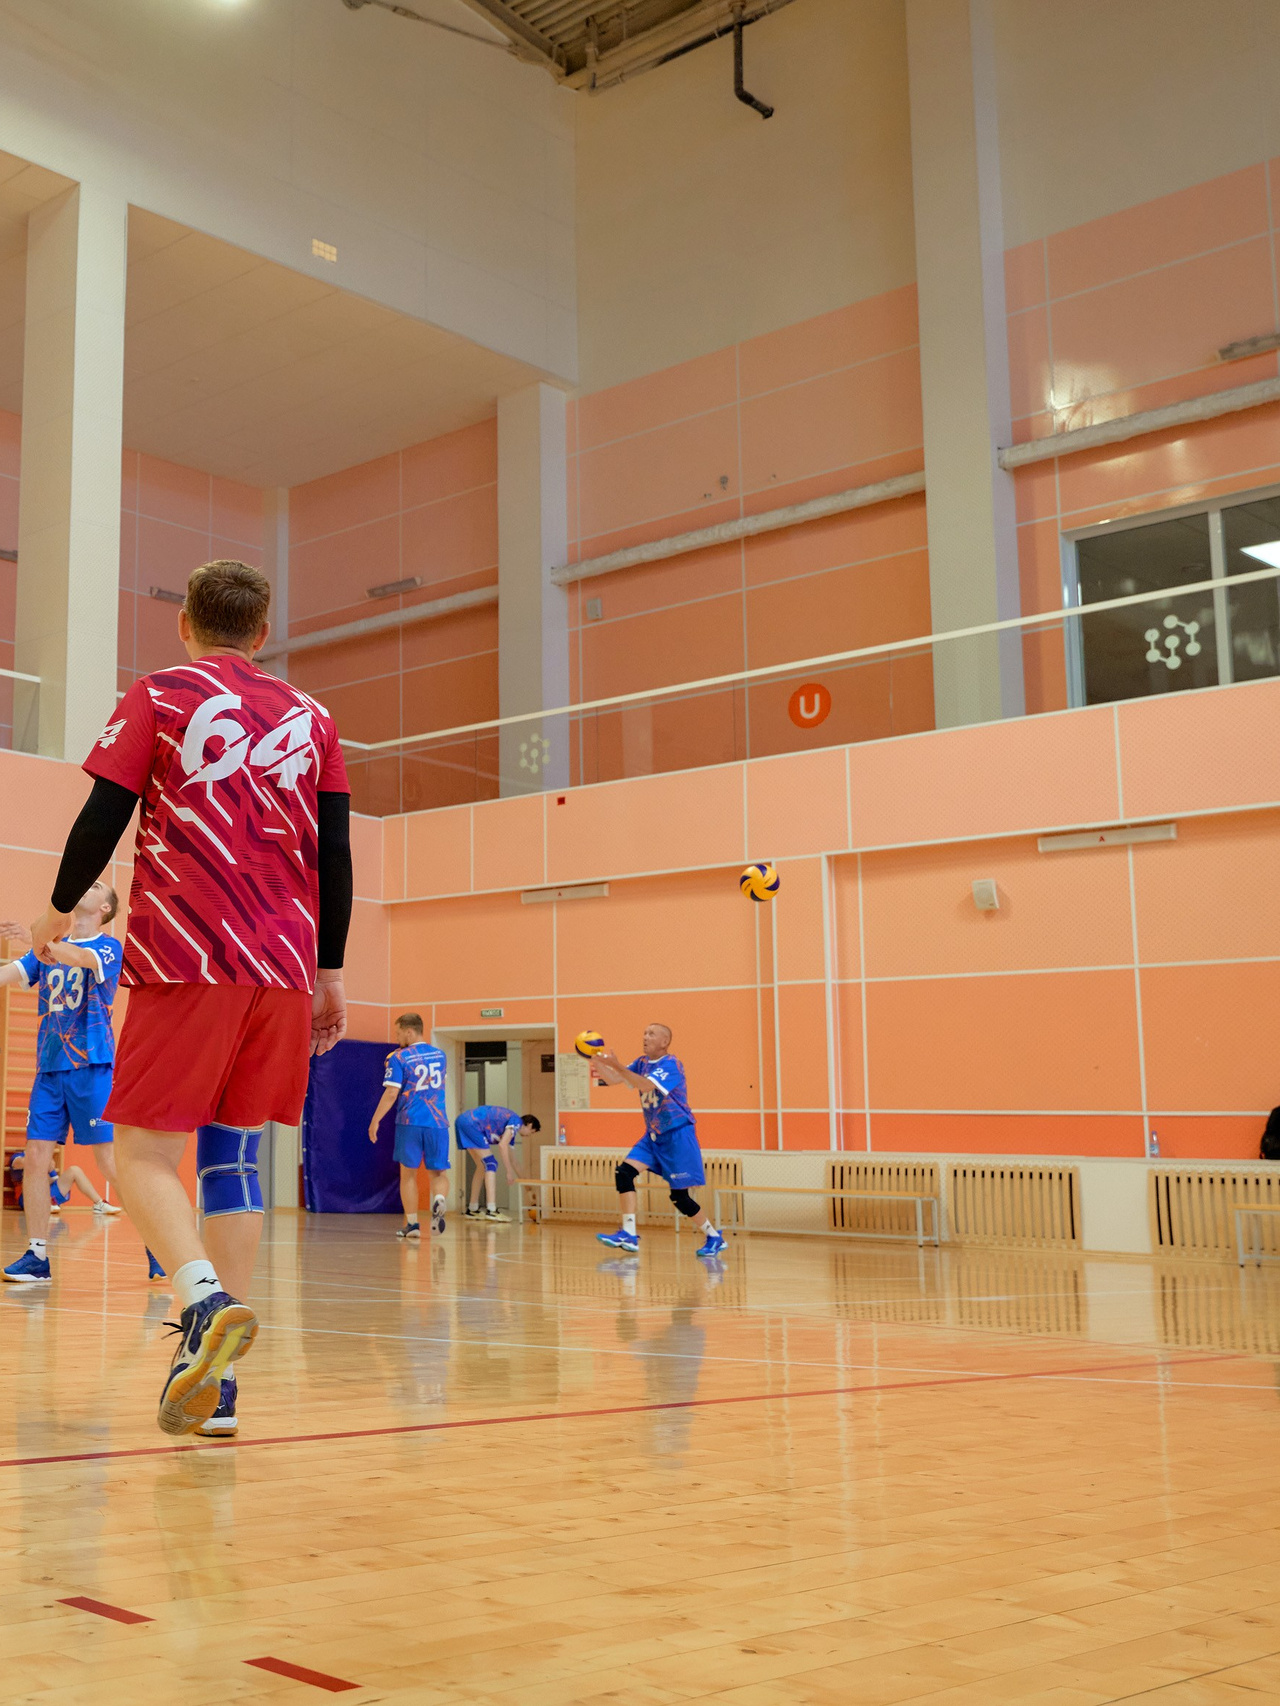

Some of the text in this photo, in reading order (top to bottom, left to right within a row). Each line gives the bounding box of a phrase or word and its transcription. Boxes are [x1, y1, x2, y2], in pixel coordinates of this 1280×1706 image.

[799, 693, 820, 719] U
[177, 694, 317, 791] 64
[99, 945, 115, 965] 23
[47, 966, 84, 1012] 23
[414, 1062, 442, 1092] 25
[652, 1067, 669, 1081] 24
